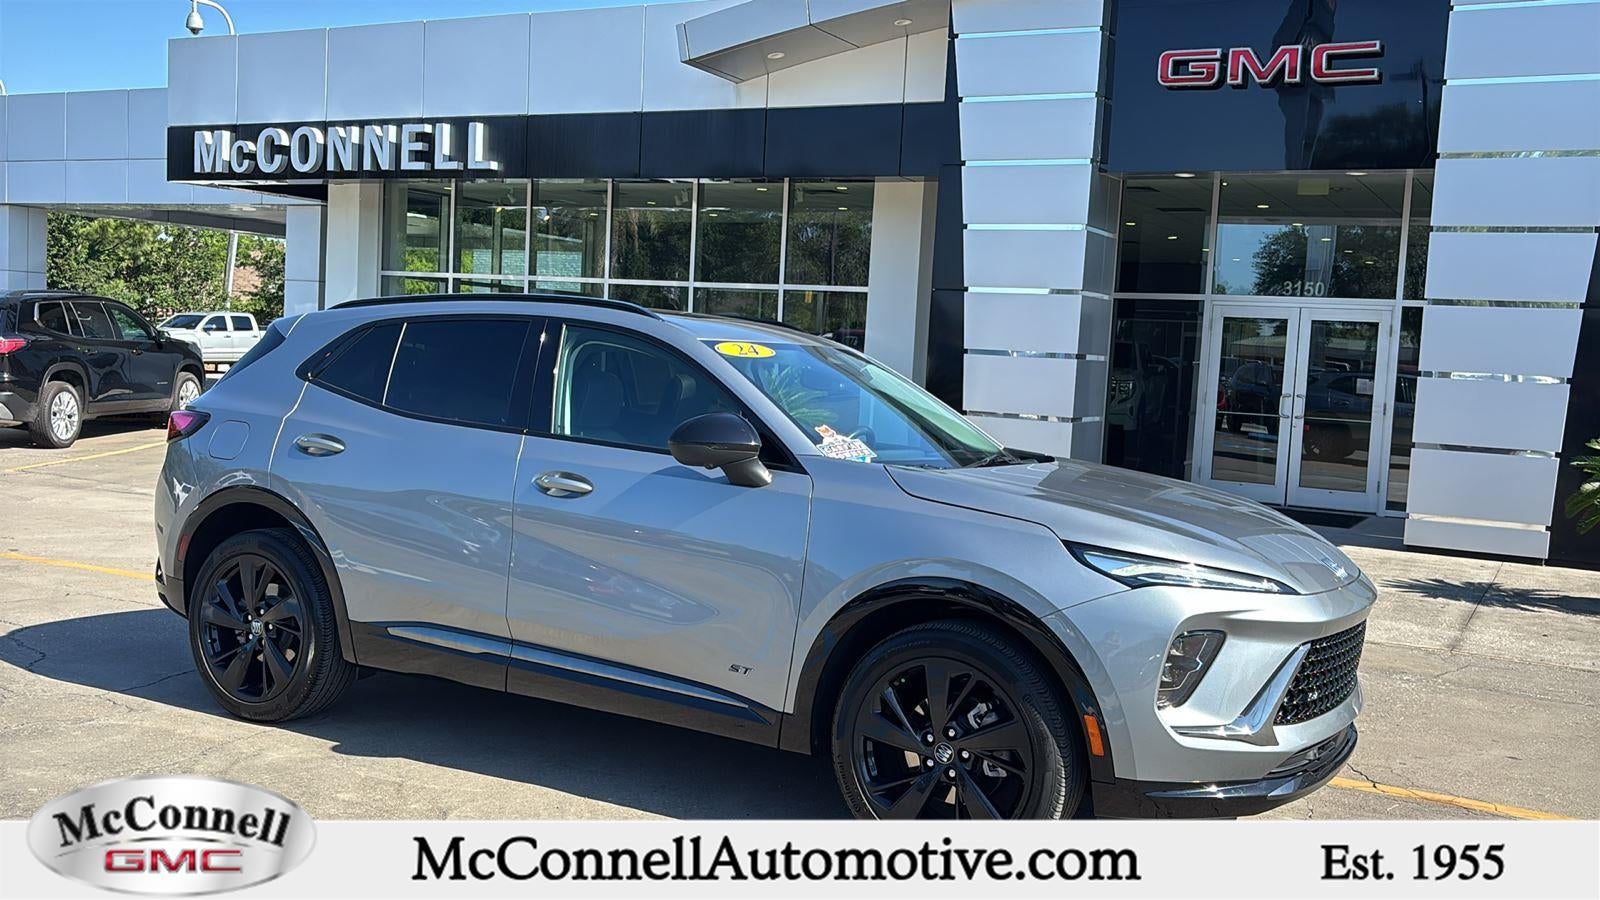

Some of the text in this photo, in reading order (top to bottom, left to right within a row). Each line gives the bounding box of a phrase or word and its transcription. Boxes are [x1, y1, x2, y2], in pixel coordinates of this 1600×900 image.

[1157, 40, 1381, 86] GMC
[193, 121, 499, 174] McCONNELL
[1283, 281, 1325, 297] 3150
[731, 343, 759, 356] 24
[728, 664, 755, 675] ST
